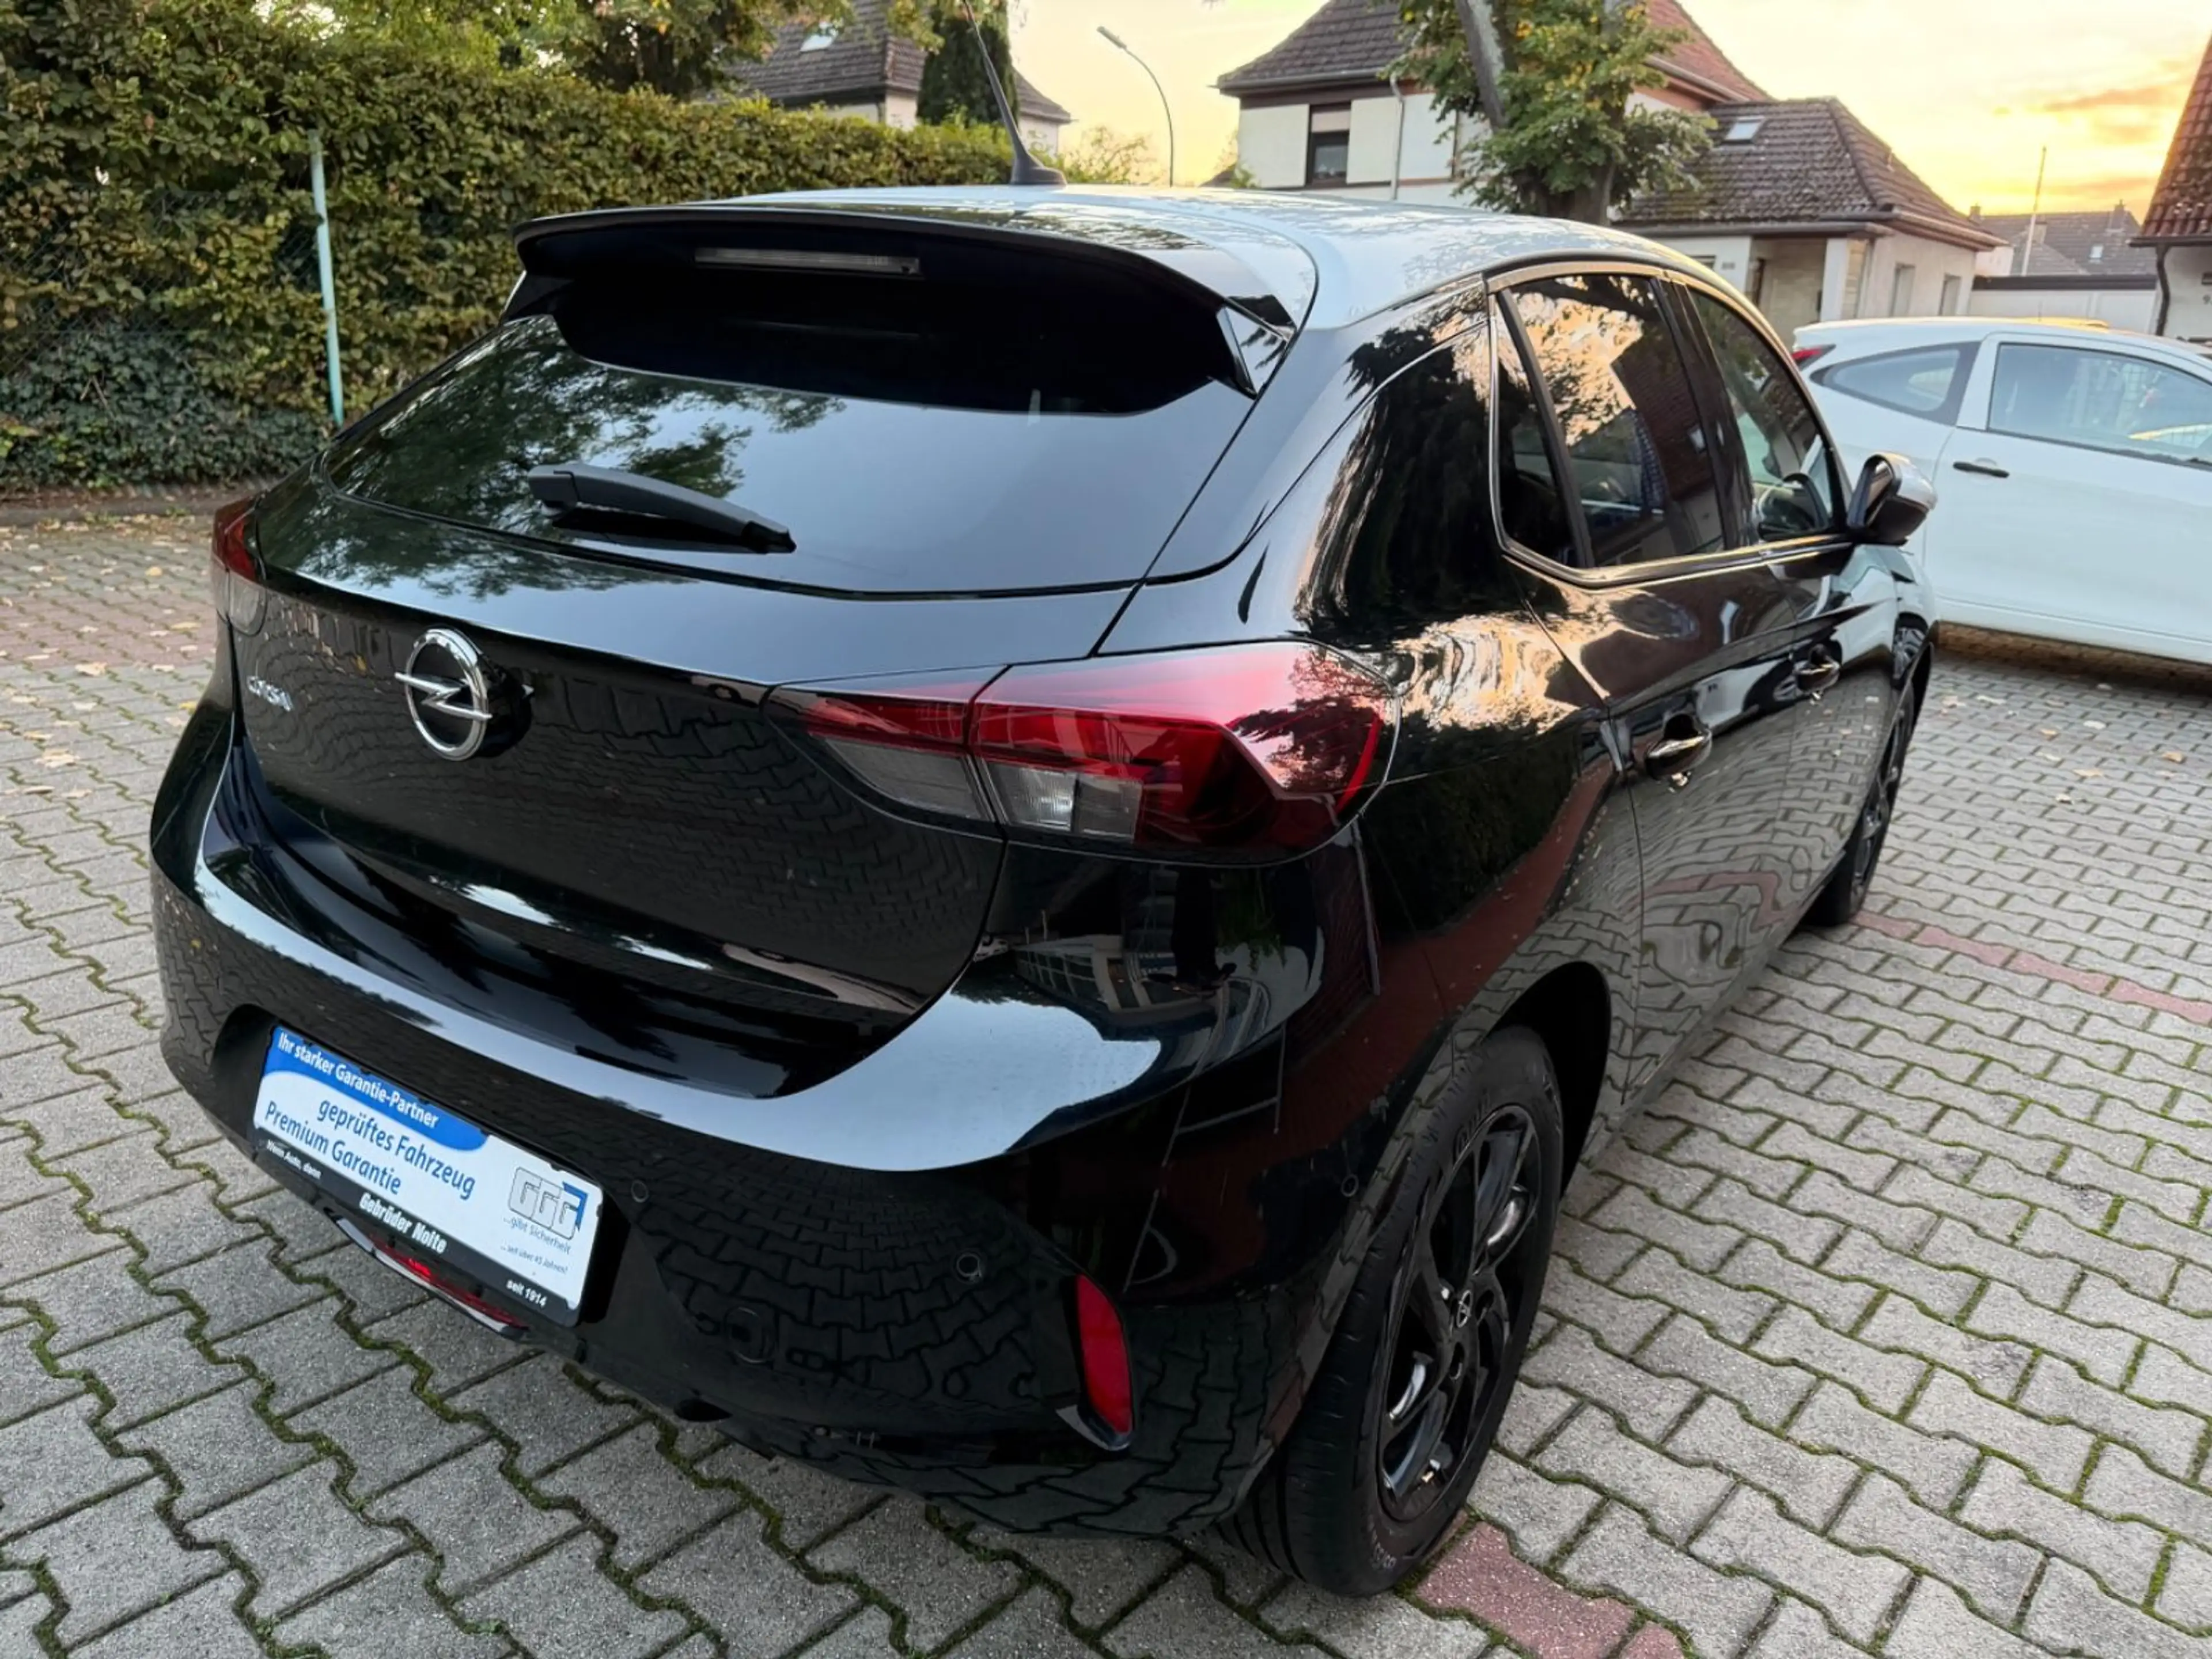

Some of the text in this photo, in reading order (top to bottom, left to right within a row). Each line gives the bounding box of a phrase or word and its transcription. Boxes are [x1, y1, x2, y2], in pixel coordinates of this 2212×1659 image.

[278, 1031, 440, 1129] Ihr starker Garantie-Partner
[264, 1101, 402, 1195] Premium Garantie
[317, 1100, 476, 1200] geprüftes Fahrzeug
[359, 1192, 413, 1234] Gebrüder
[525, 1287, 547, 1308] 1914
